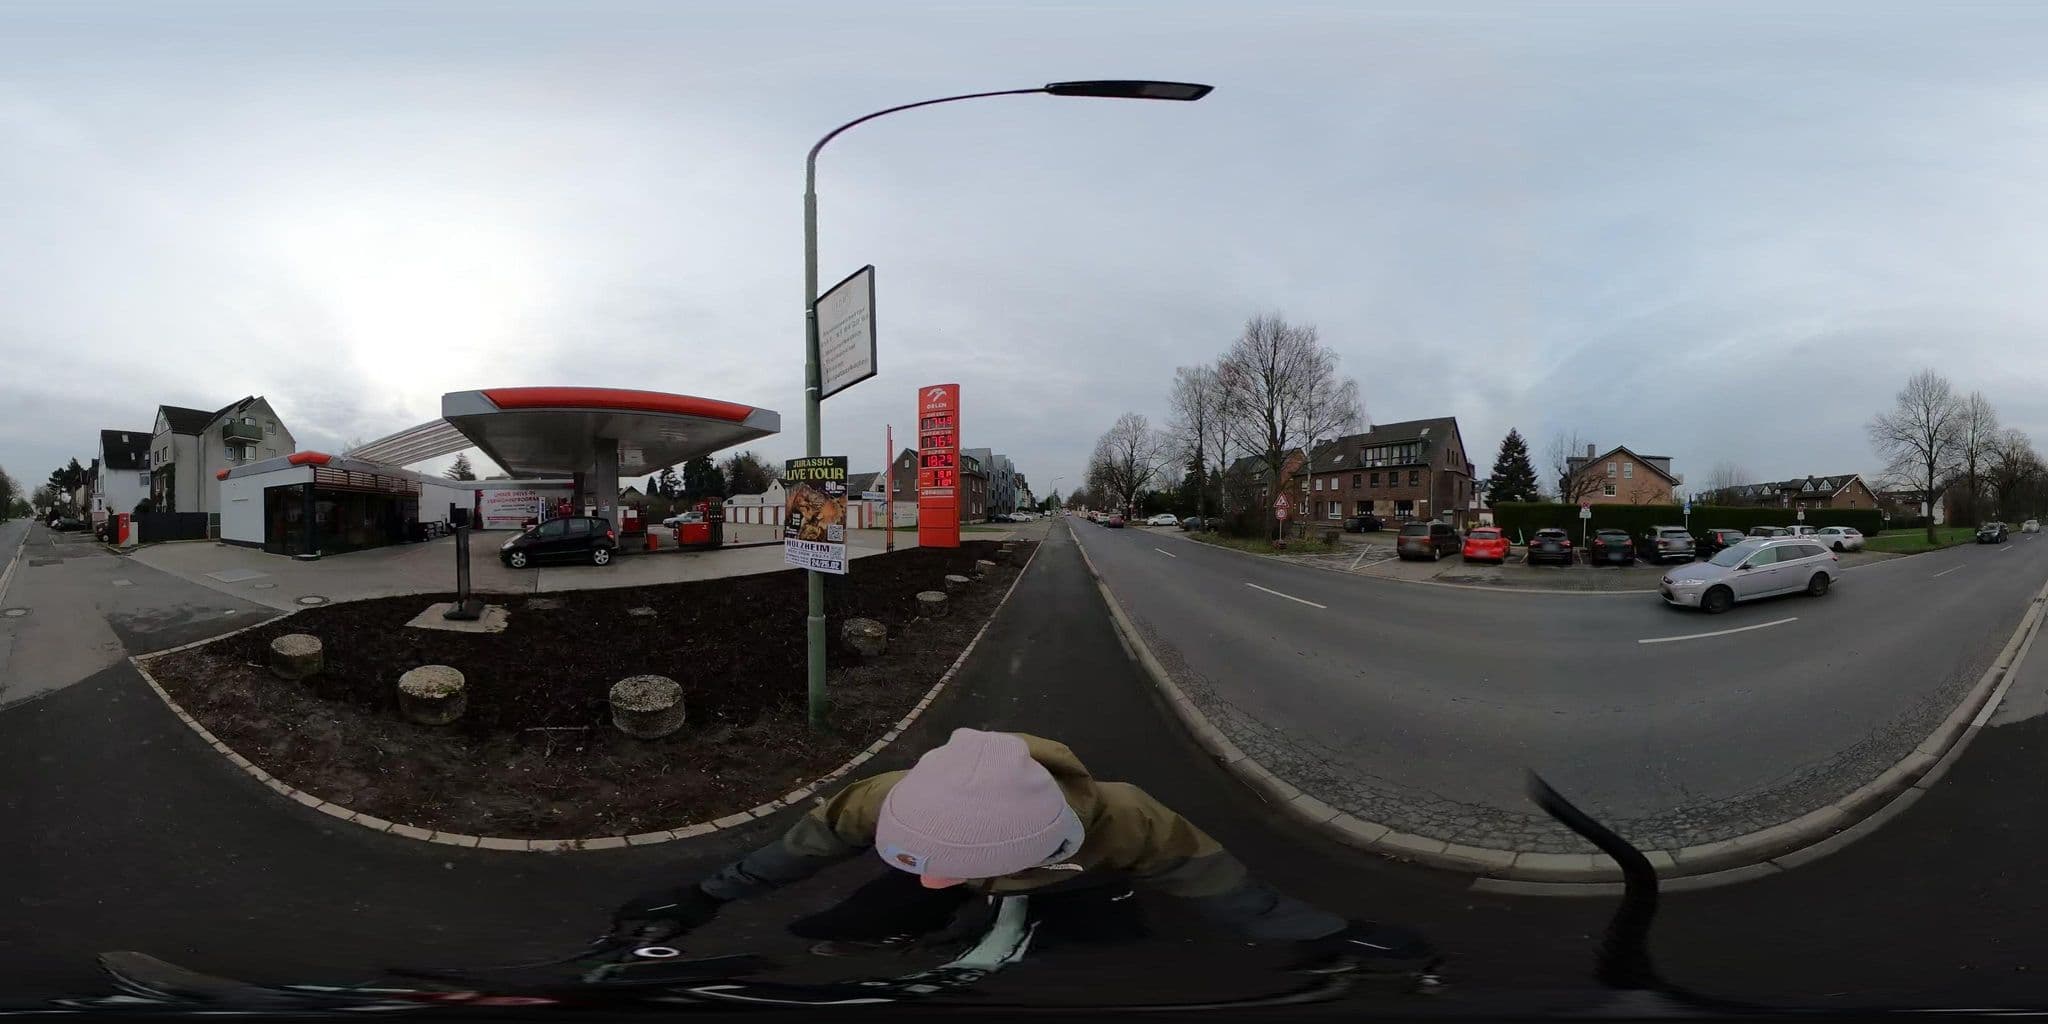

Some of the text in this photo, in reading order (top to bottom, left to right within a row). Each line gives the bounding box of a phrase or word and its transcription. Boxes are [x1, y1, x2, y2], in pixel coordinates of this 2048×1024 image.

[793, 457, 834, 469] JURASSIC
[786, 467, 845, 481] LIVE TOUR
